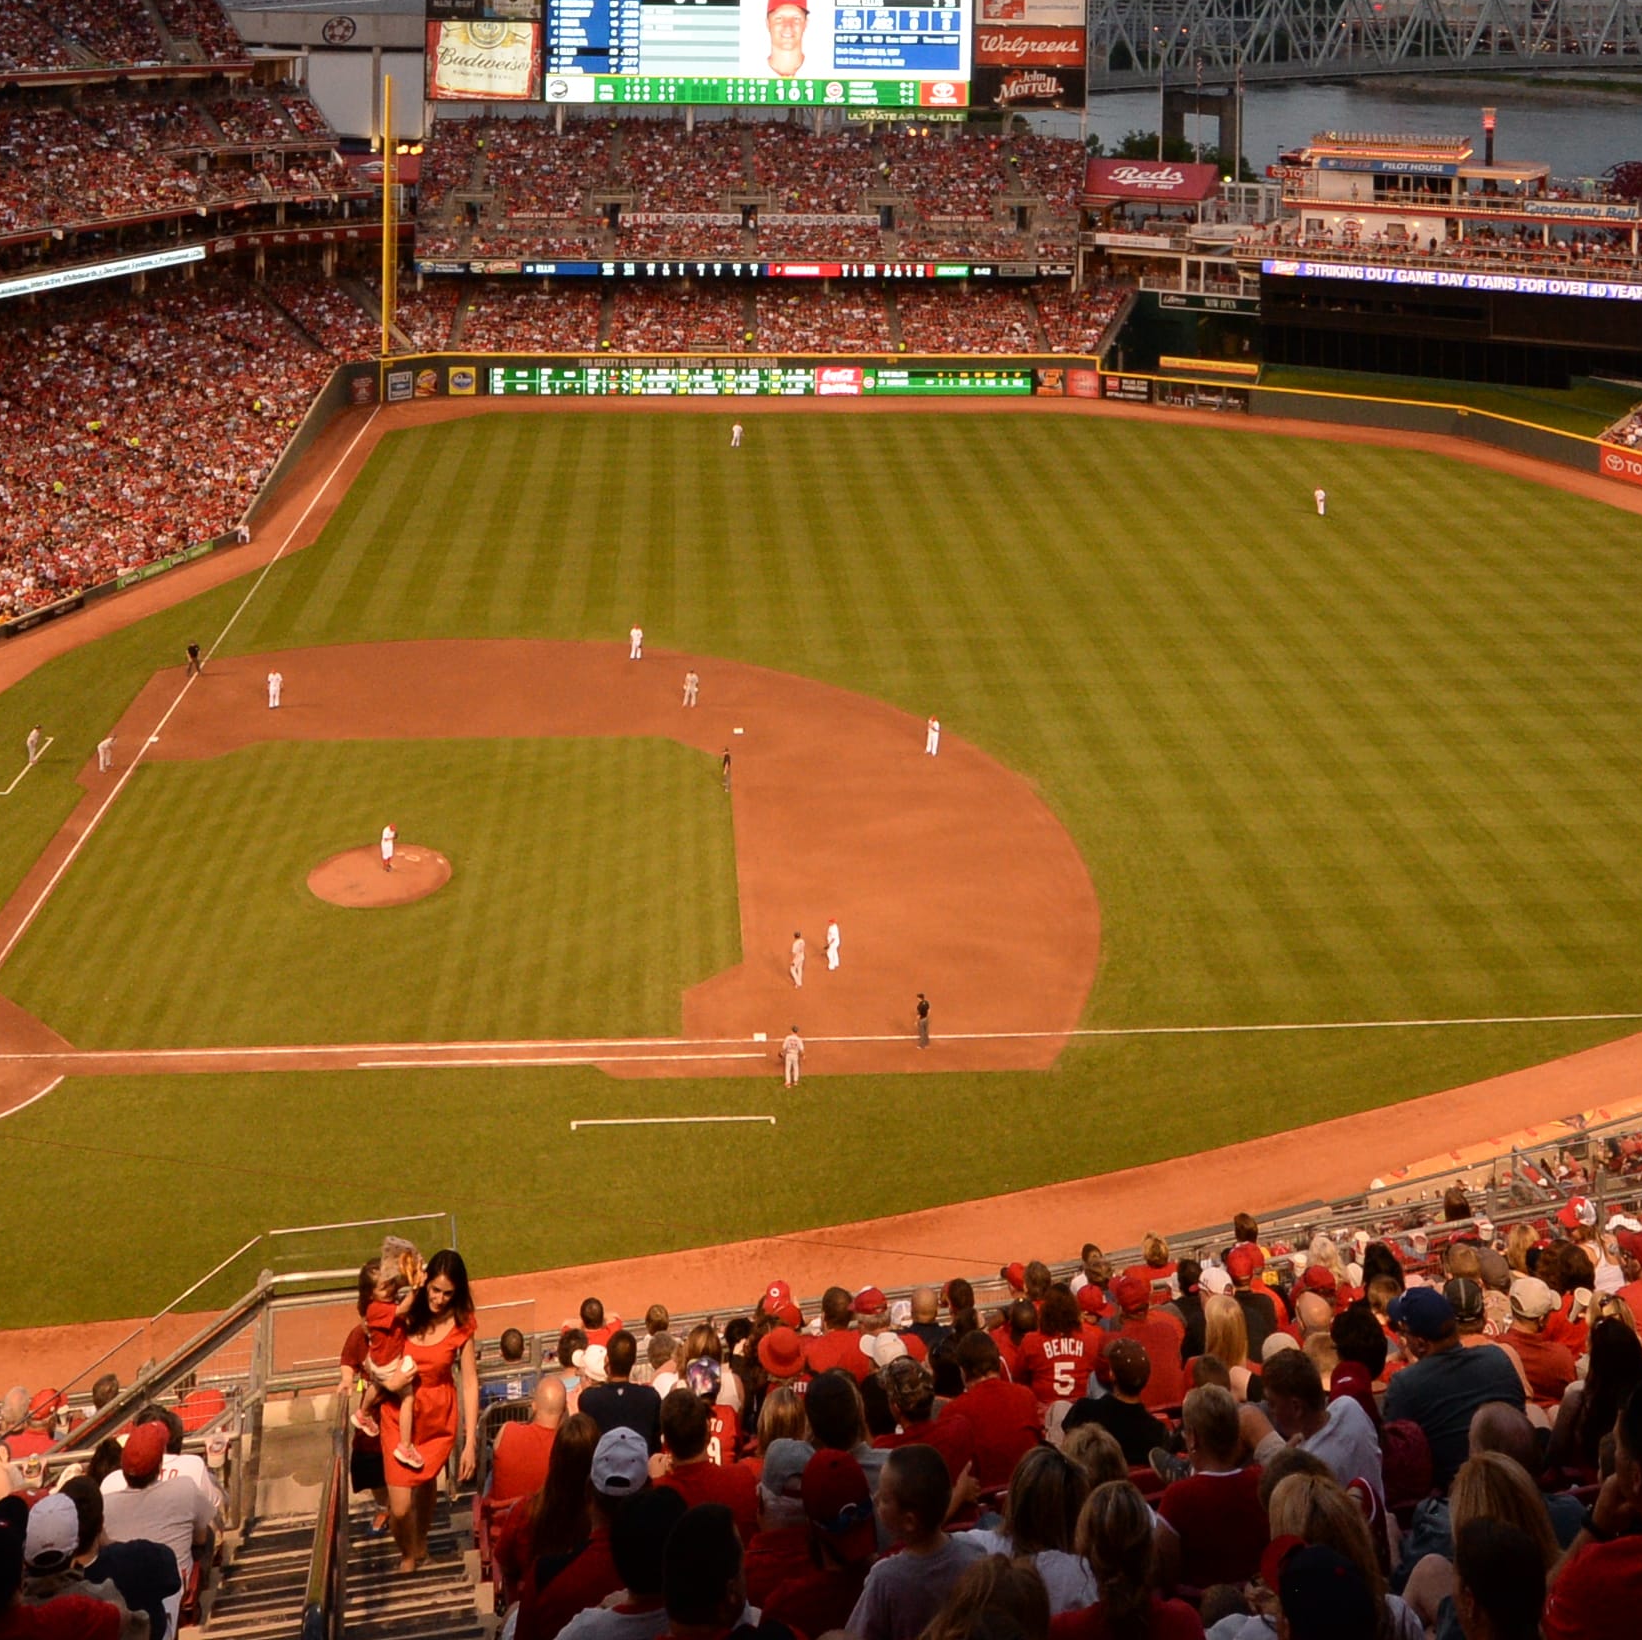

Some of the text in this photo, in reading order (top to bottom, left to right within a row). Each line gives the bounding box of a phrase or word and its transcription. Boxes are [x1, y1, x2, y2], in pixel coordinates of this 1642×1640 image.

[437, 45, 531, 71] Budweiser
[979, 34, 1080, 58] Walgreens
[994, 77, 1064, 102] Morrell
[1109, 166, 1185, 185] Reds
[1383, 161, 1443, 172] PILOT HOUSE
[1525, 203, 1636, 220] Cincinnati Bell
[1305, 264, 1364, 280] STRIKING
[1366, 268, 1396, 282] OUT
[1397, 270, 1436, 285] GAME
[1438, 273, 1467, 287] DAY
[1467, 275, 1517, 291] STAINS
[1518, 278, 1547, 293] FOR
[1548, 280, 1588, 296] OVER
[1590, 283, 1607, 298] 40
[1043, 1337, 1084, 1360] BENCH
[1052, 1361, 1077, 1397] 5
